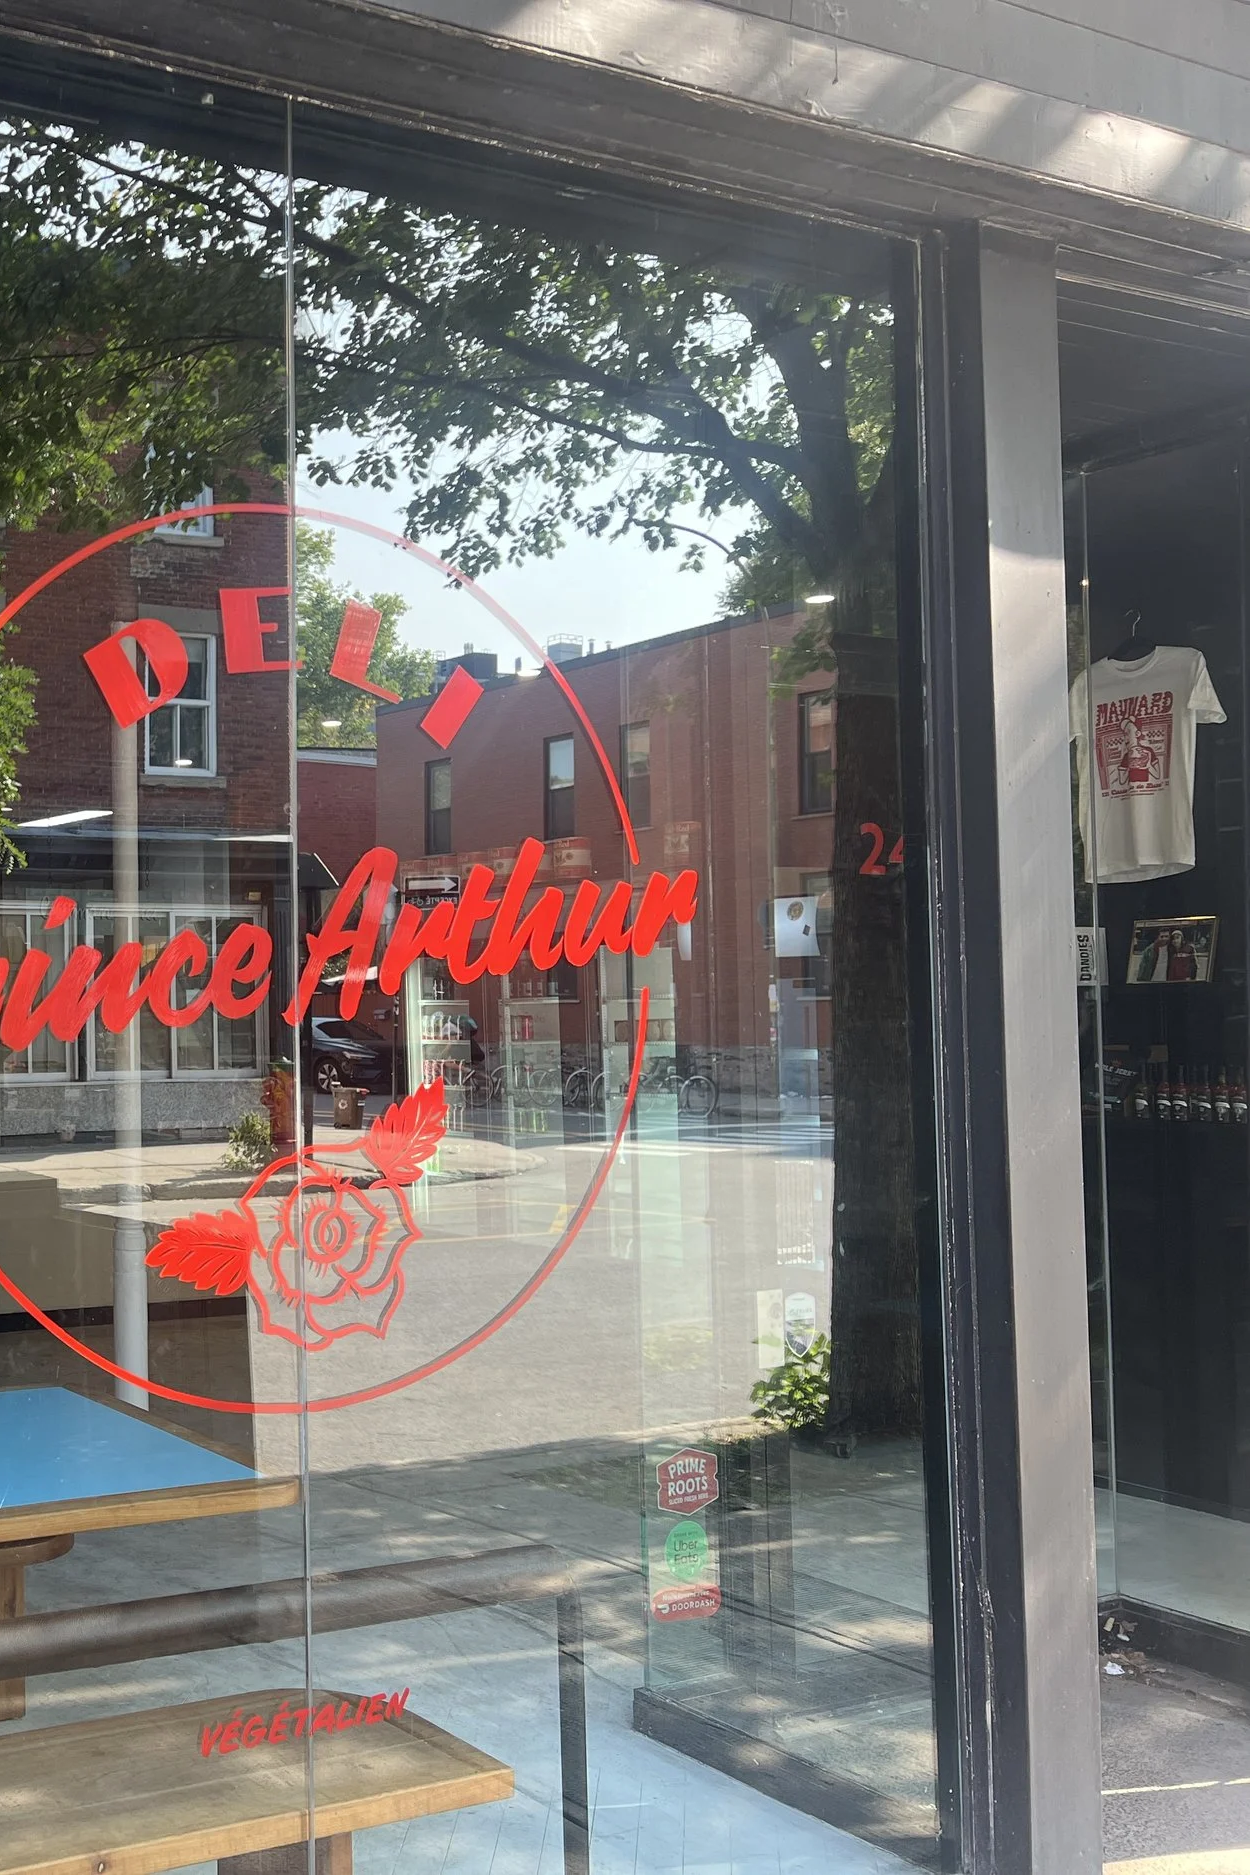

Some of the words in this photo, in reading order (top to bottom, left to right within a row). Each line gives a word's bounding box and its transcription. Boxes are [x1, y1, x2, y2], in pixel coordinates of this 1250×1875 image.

[84, 586, 484, 749] DELI
[282, 837, 699, 1025] Arthur
[1077, 935, 1093, 982] DANDIES
[668, 1458, 707, 1480] PRIME
[668, 1475, 708, 1497] ROOTS
[674, 1539, 698, 1552] Uber
[674, 1553, 700, 1565] Eats
[671, 1599, 716, 1612] DOORDASH
[200, 1687, 411, 1758] VÉGÉTALIEN
